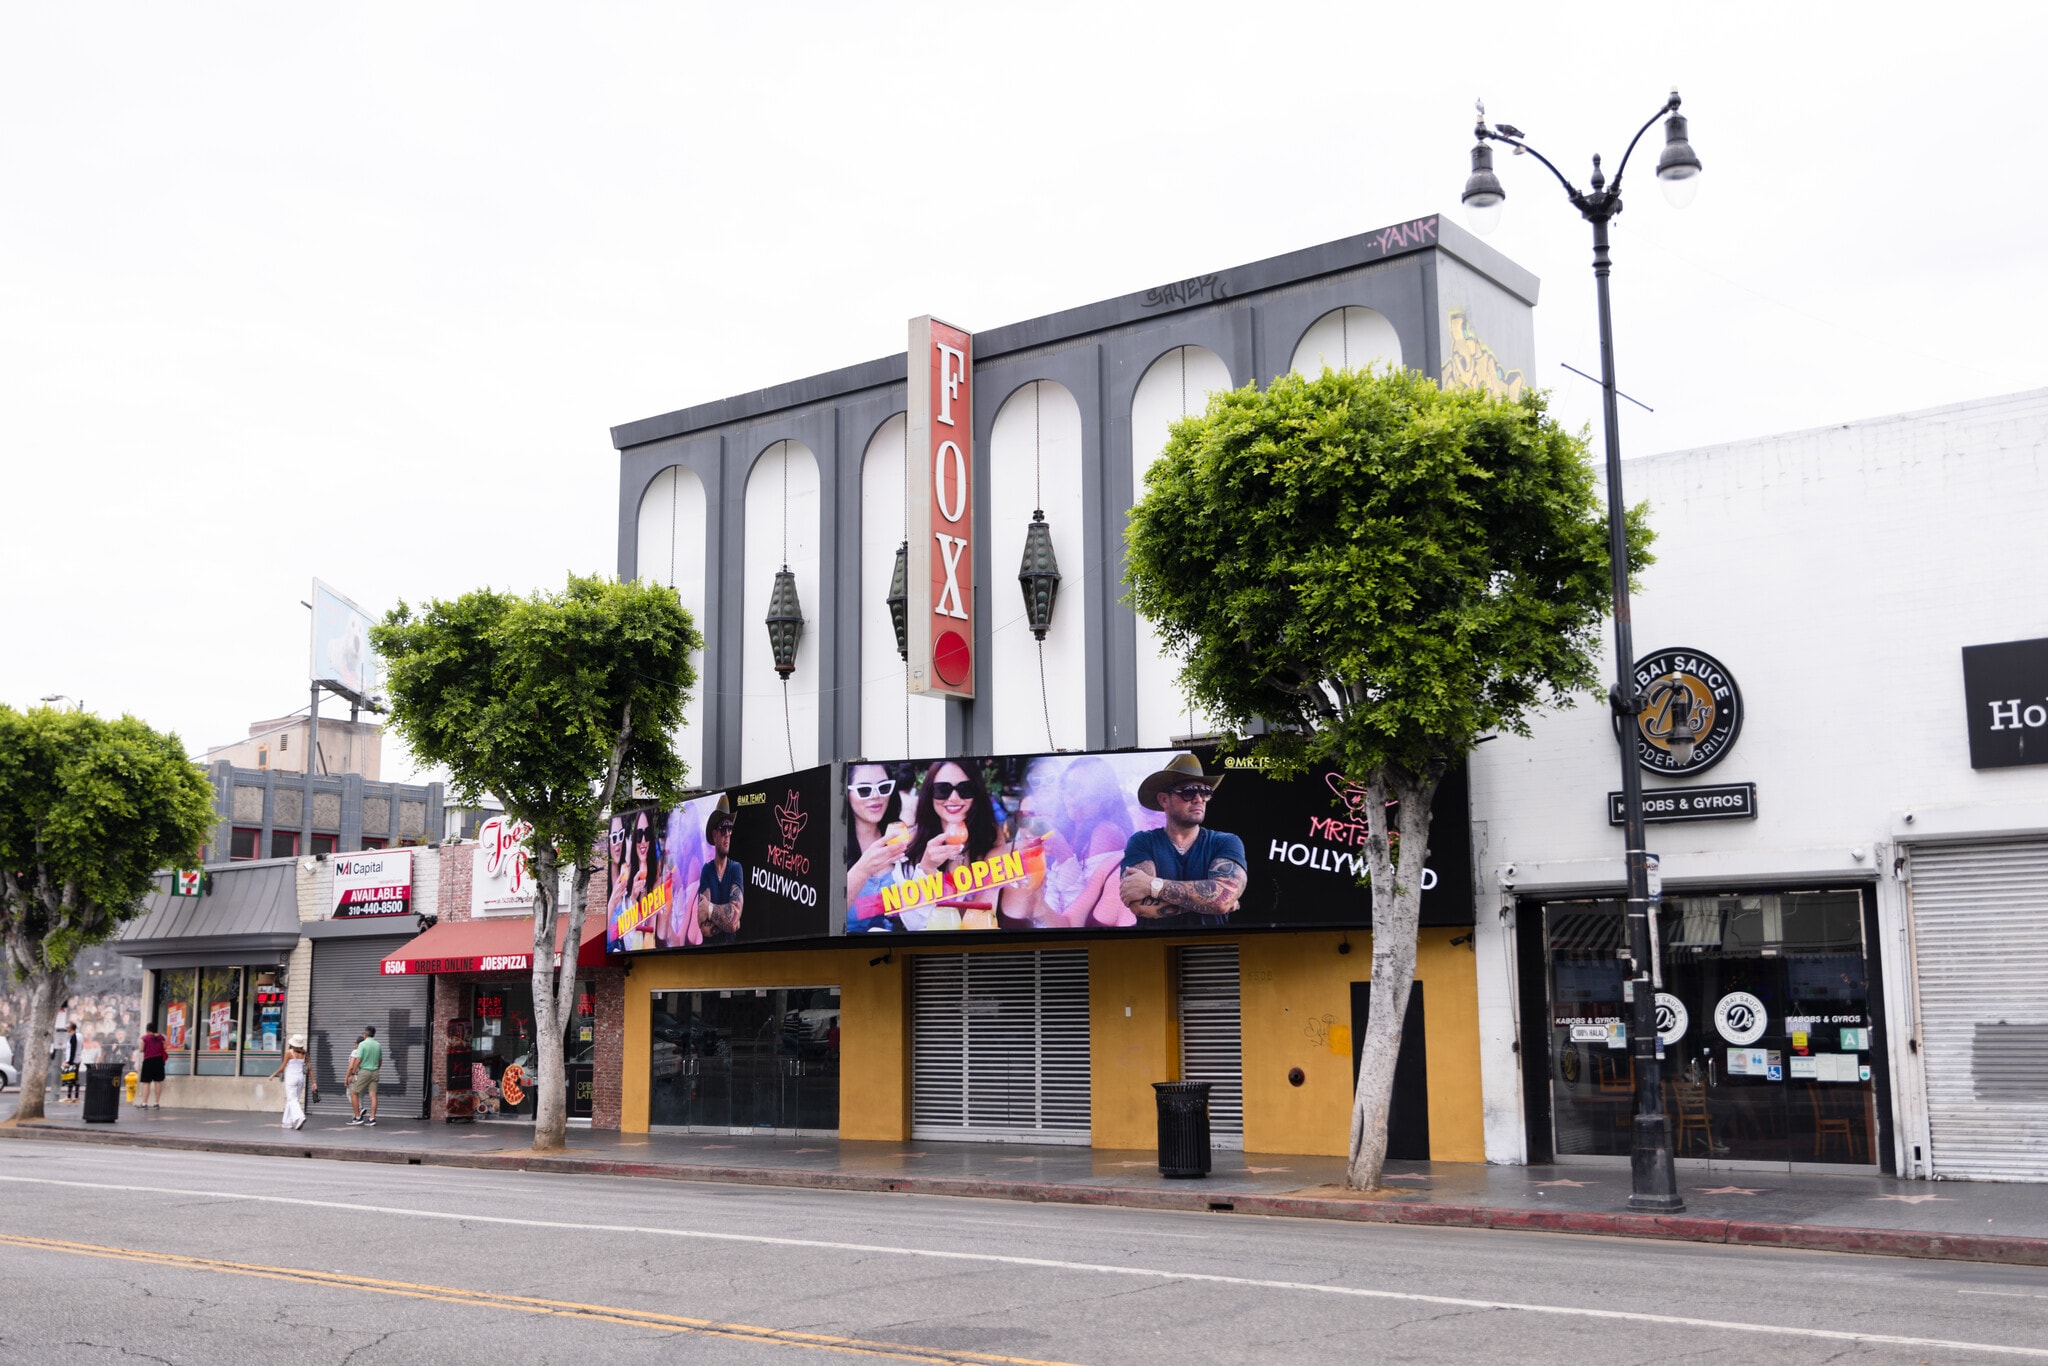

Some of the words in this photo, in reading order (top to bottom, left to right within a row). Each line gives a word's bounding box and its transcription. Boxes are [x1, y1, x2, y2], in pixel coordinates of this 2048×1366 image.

[935, 342, 968, 620] FOX
[1635, 659, 1667, 695] UBAI
[1674, 656, 1729, 700] SAUCE
[1988, 697, 2048, 731] Ho
[1638, 738, 1687, 767] ODER
[1692, 725, 1729, 762] GRILL
[1618, 800, 1674, 814] KOBS
[1679, 798, 1688, 810] &
[1693, 794, 1742, 809] GYROS
[336, 861, 352, 876] NAI
[353, 861, 383, 875] Capital
[1269, 839, 1438, 890] HOLLYWD
[752, 866, 817, 907] HOLLYWOOD
[881, 871, 944, 912] NOW
[953, 850, 1025, 892] OPEN
[350, 887, 403, 903] AVAILABLE
[348, 900, 403, 916] 310-440-8500
[618, 902, 640, 933] NOW
[641, 884, 665, 918] OPEN
[385, 960, 406, 974] 6504
[414, 959, 441, 973] ORDER
[444, 957, 474, 971] ONLINE
[1740, 995, 1761, 1015] SAUCE
[1595, 1016, 1620, 1024] GYROS
[1787, 1015, 1821, 1023] KABOBS
[1823, 1015, 1829, 1023] &
[1832, 1015, 1860, 1023] GYROS
[1844, 1033, 1856, 1045] A
[577, 1081, 593, 1091] OPE
